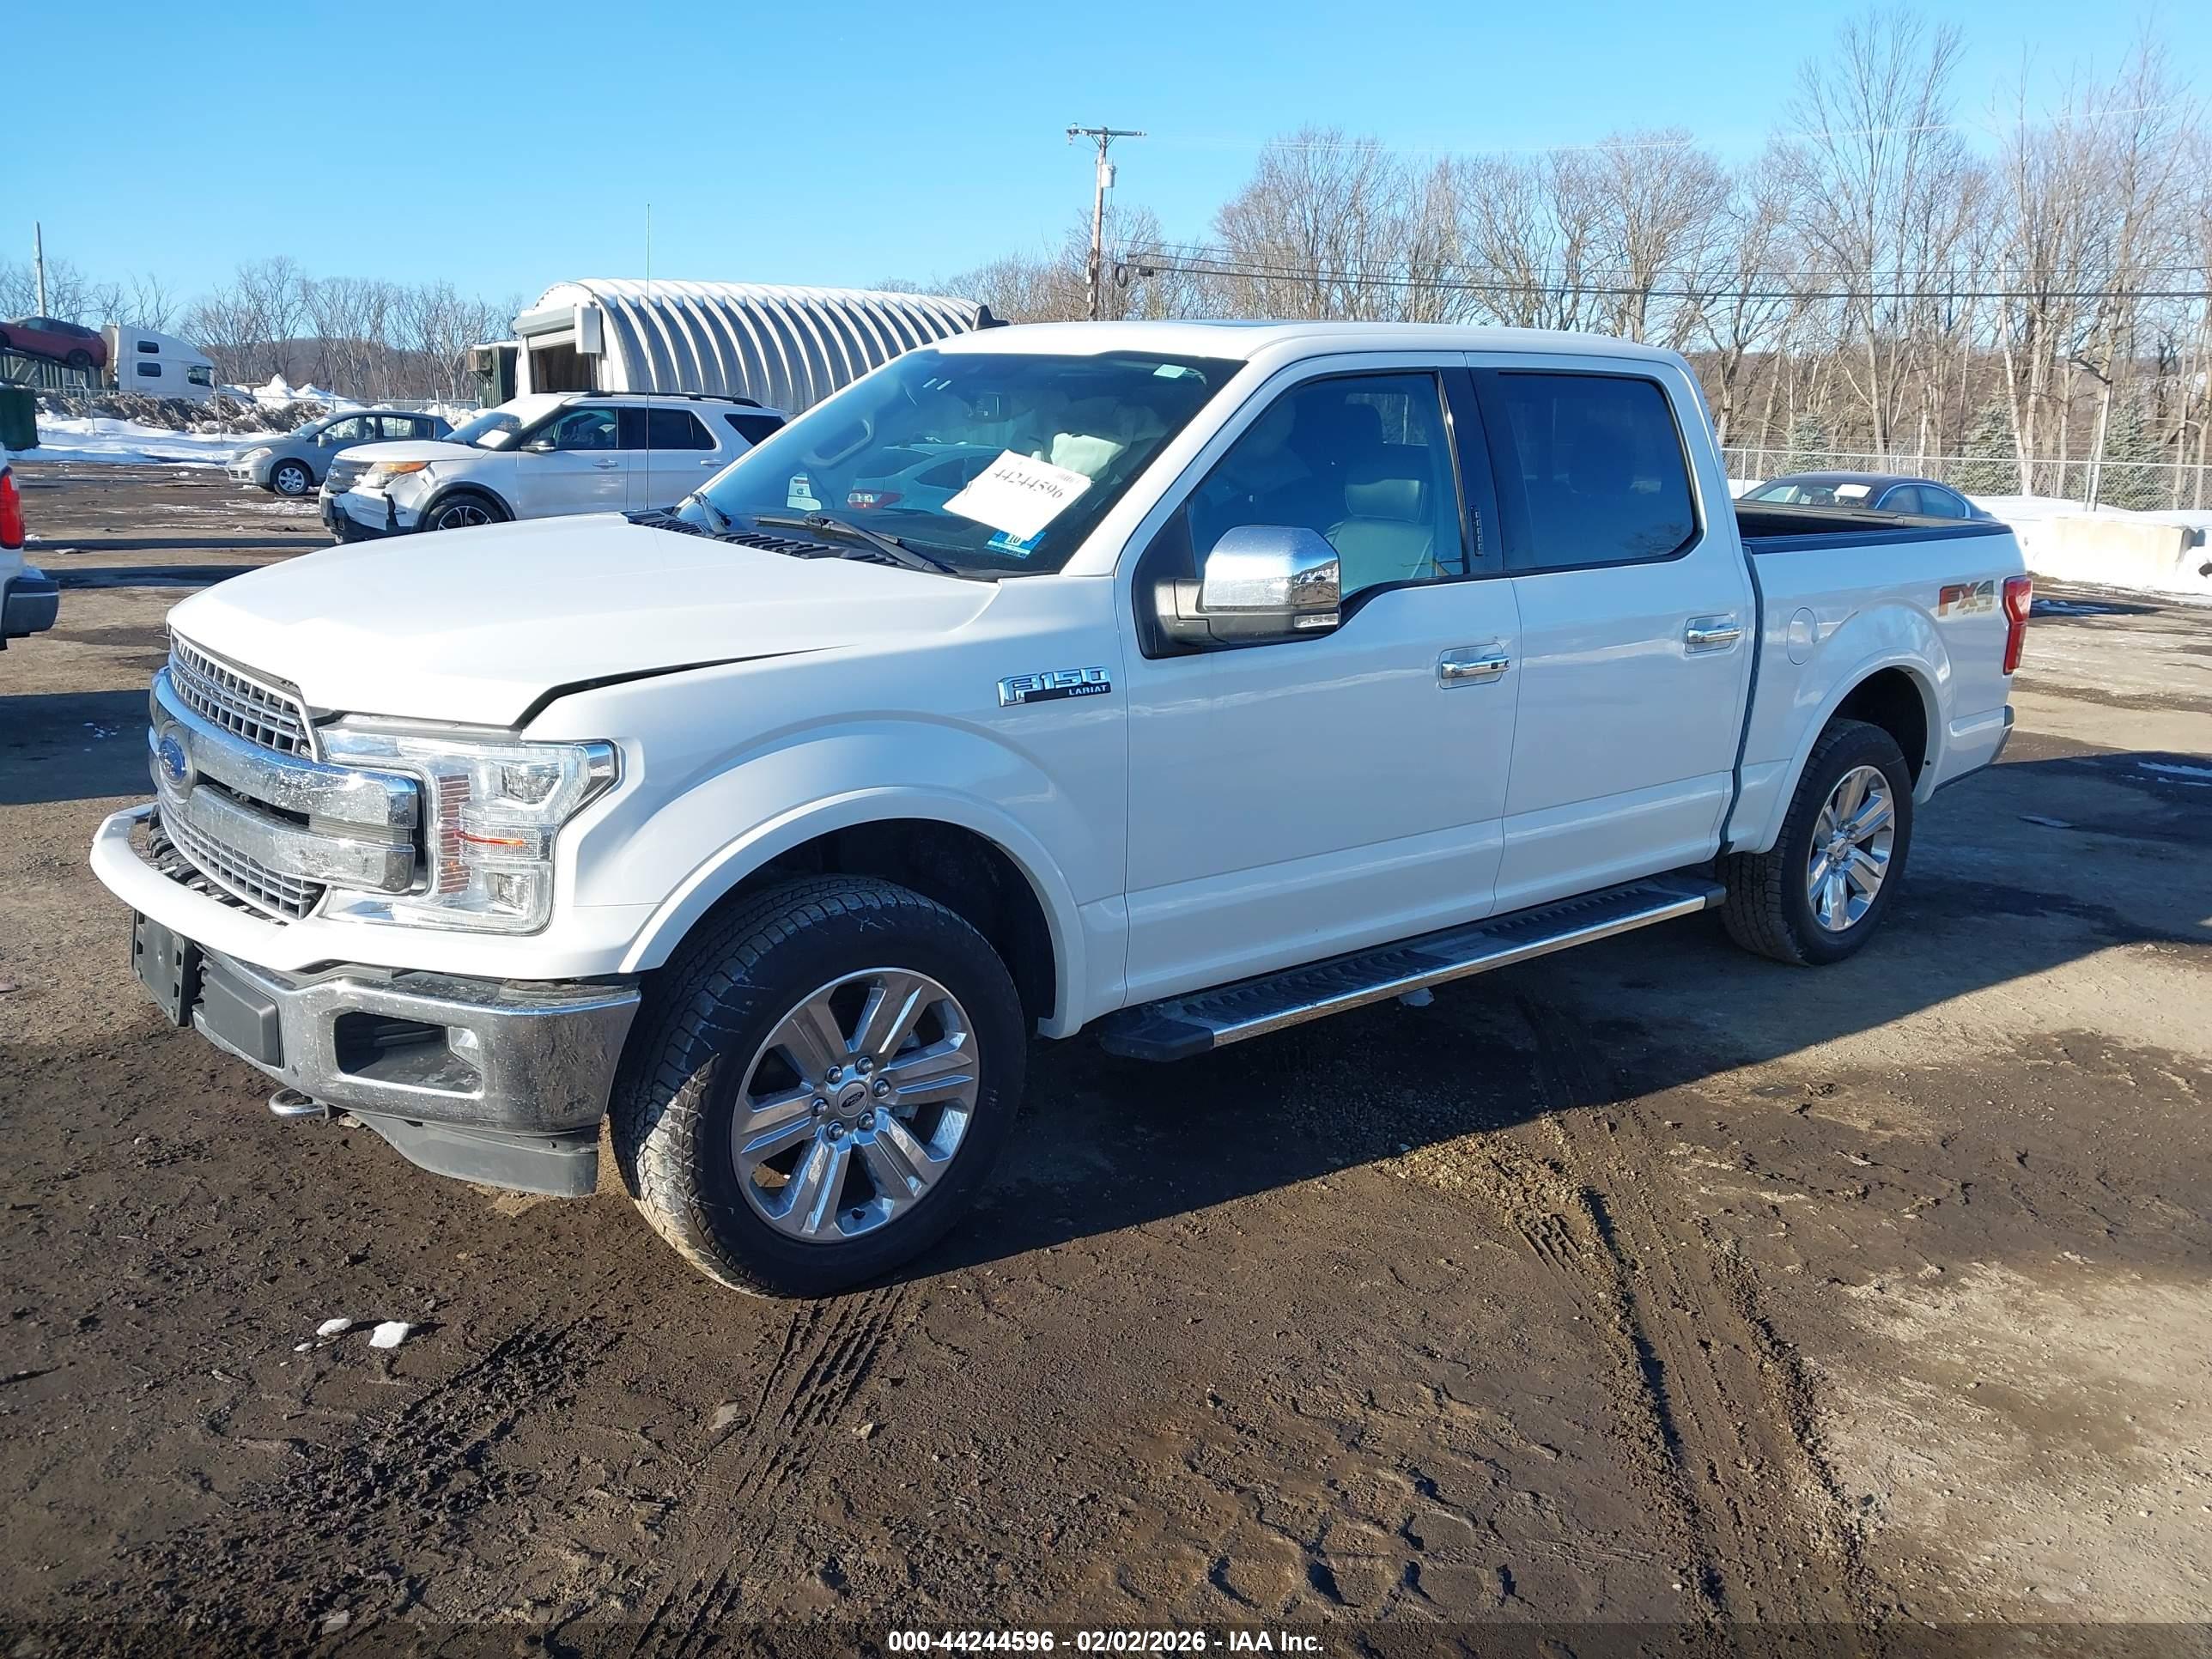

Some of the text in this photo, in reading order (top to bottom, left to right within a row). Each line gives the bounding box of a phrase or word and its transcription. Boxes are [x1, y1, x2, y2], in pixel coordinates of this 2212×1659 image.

[994, 468, 1064, 499] 44244596
[1938, 580, 1995, 617] FX4
[1068, 684, 1107, 696] LARIAT
